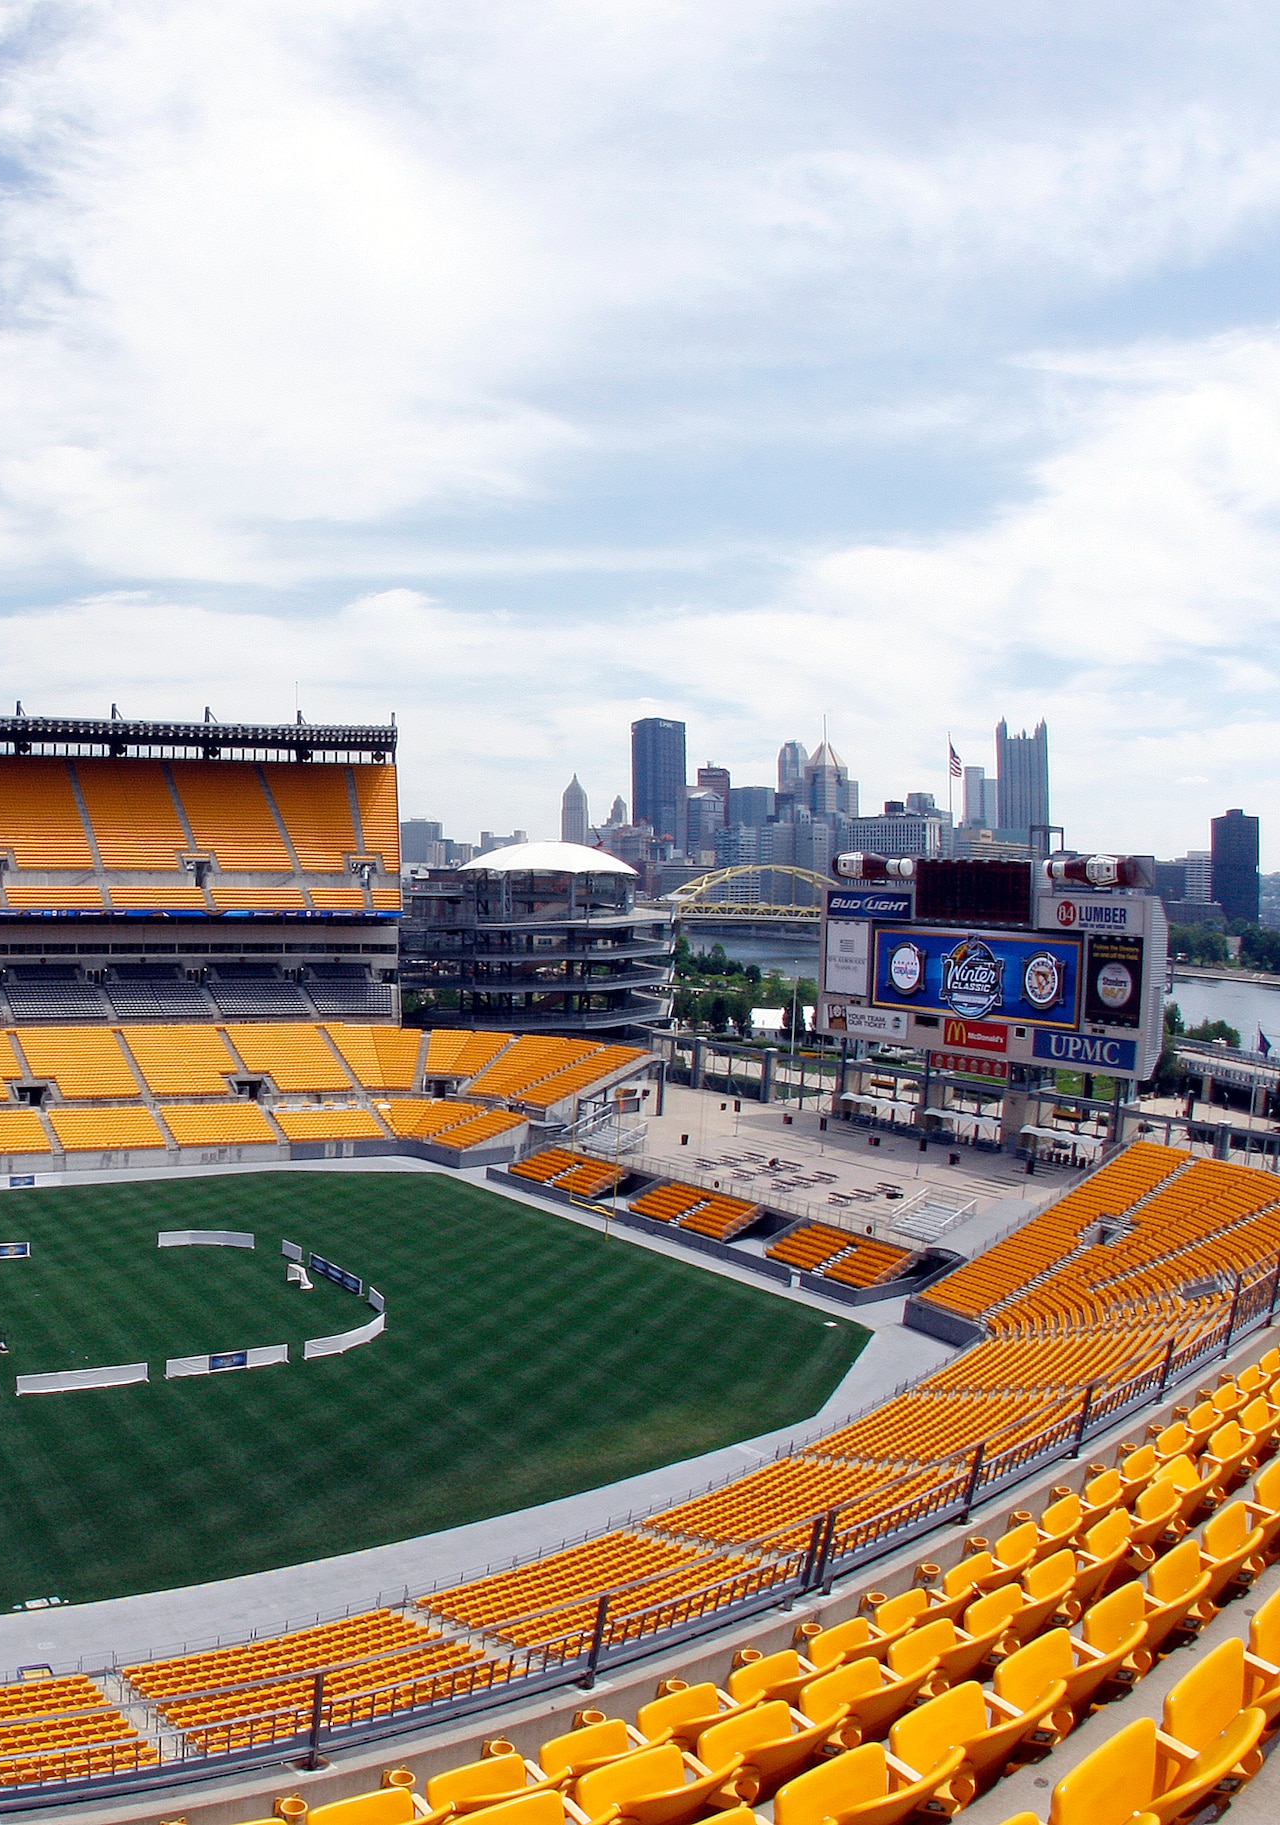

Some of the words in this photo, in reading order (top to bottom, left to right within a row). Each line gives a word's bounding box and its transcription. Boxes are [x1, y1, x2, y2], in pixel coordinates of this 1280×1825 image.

[830, 898, 861, 909] BUD
[867, 900, 908, 911] LIGHT
[1058, 905, 1074, 921] 84
[1079, 906, 1126, 924] LUMBER
[944, 957, 996, 988] Winter
[951, 982, 991, 992] CLASSIC
[968, 1032, 1004, 1043] McDonald's
[1049, 1034, 1120, 1065] UPMC
